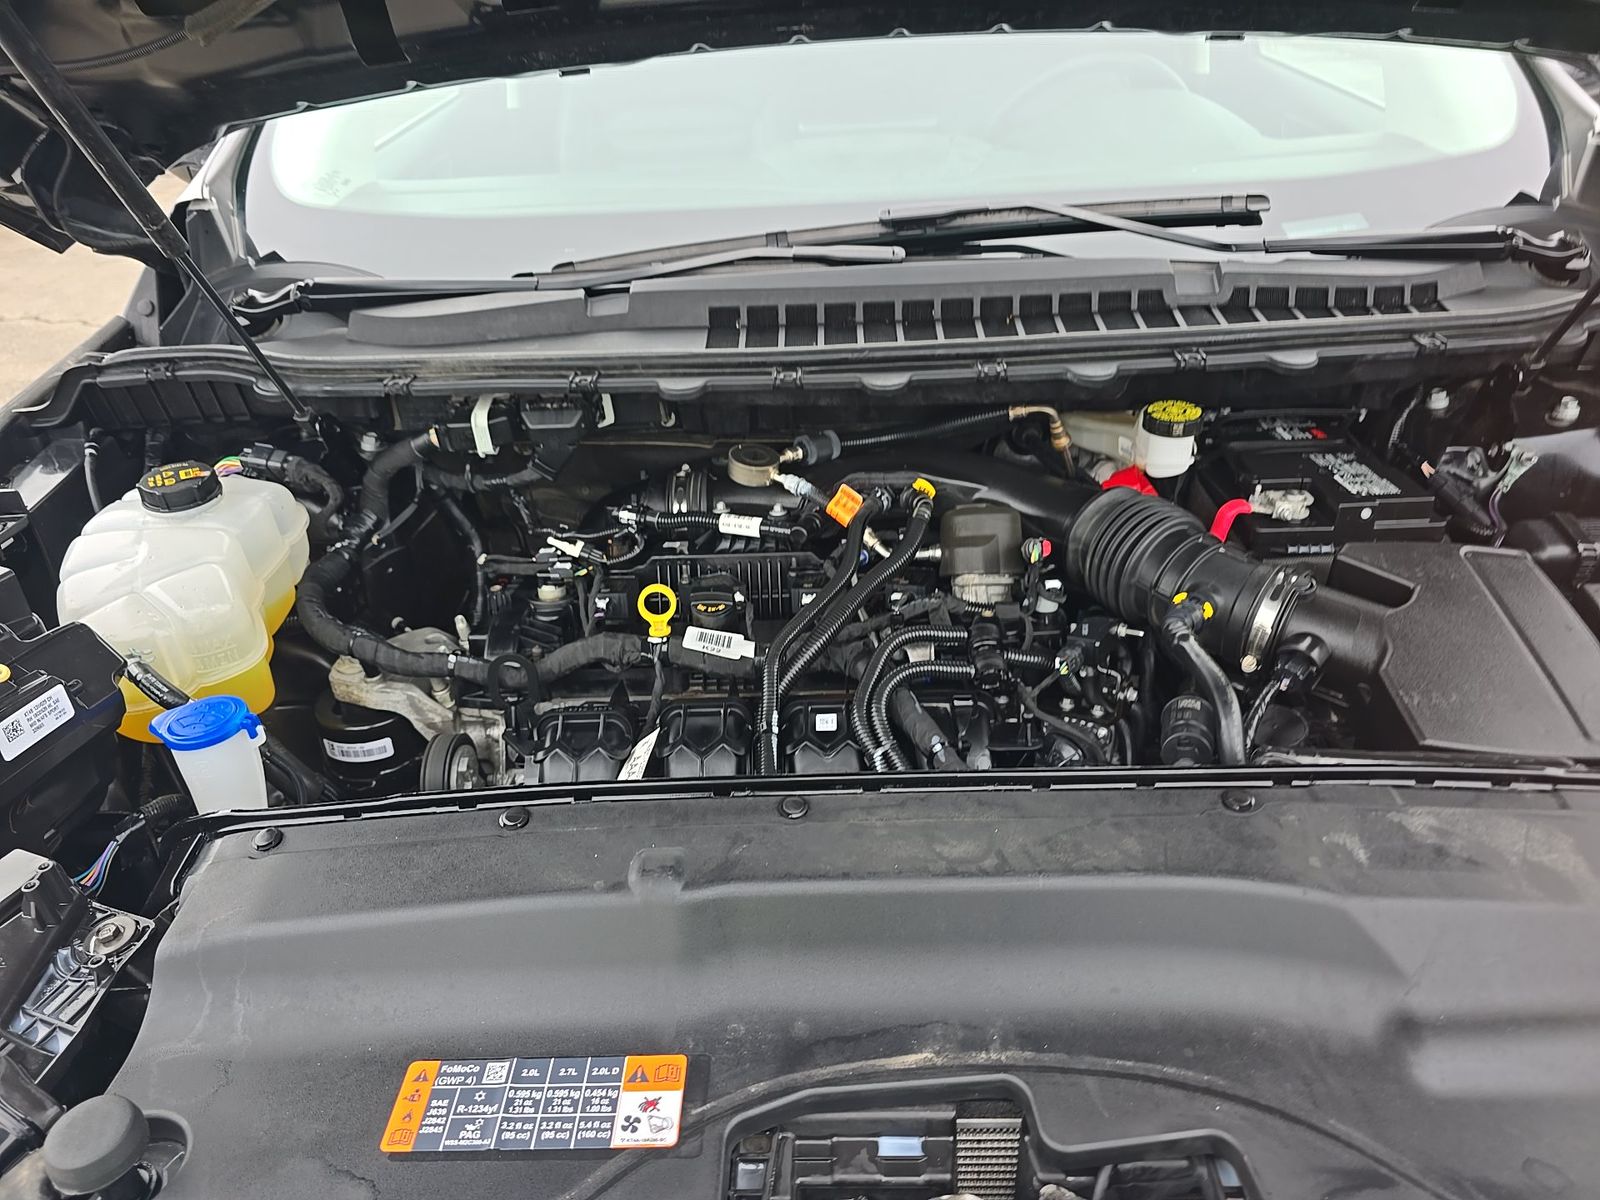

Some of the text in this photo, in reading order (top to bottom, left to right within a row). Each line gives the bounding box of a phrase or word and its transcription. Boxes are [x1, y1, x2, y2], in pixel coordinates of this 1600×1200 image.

[440, 1064, 480, 1074] FoMoCo
[521, 1069, 540, 1077] 2.0L
[559, 1068, 578, 1076] 2.7L
[592, 1068, 610, 1076] 2.0L
[435, 1076, 477, 1086] (GWP 4)
[532, 1090, 543, 1100] kg
[570, 1089, 580, 1099] kg
[608, 1088, 618, 1099] kg
[431, 1099, 449, 1107] SAE
[457, 1104, 499, 1115] R-1234yf
[501, 1121, 515, 1129] 3.2
[540, 1121, 554, 1129] 3.2
[579, 1121, 593, 1129] 5.4
[459, 1131, 481, 1139] PAG
[501, 1131, 531, 1140] (95 cc)
[541, 1130, 570, 1140] (95 cc)
[597, 1130, 611, 1139] cc)
